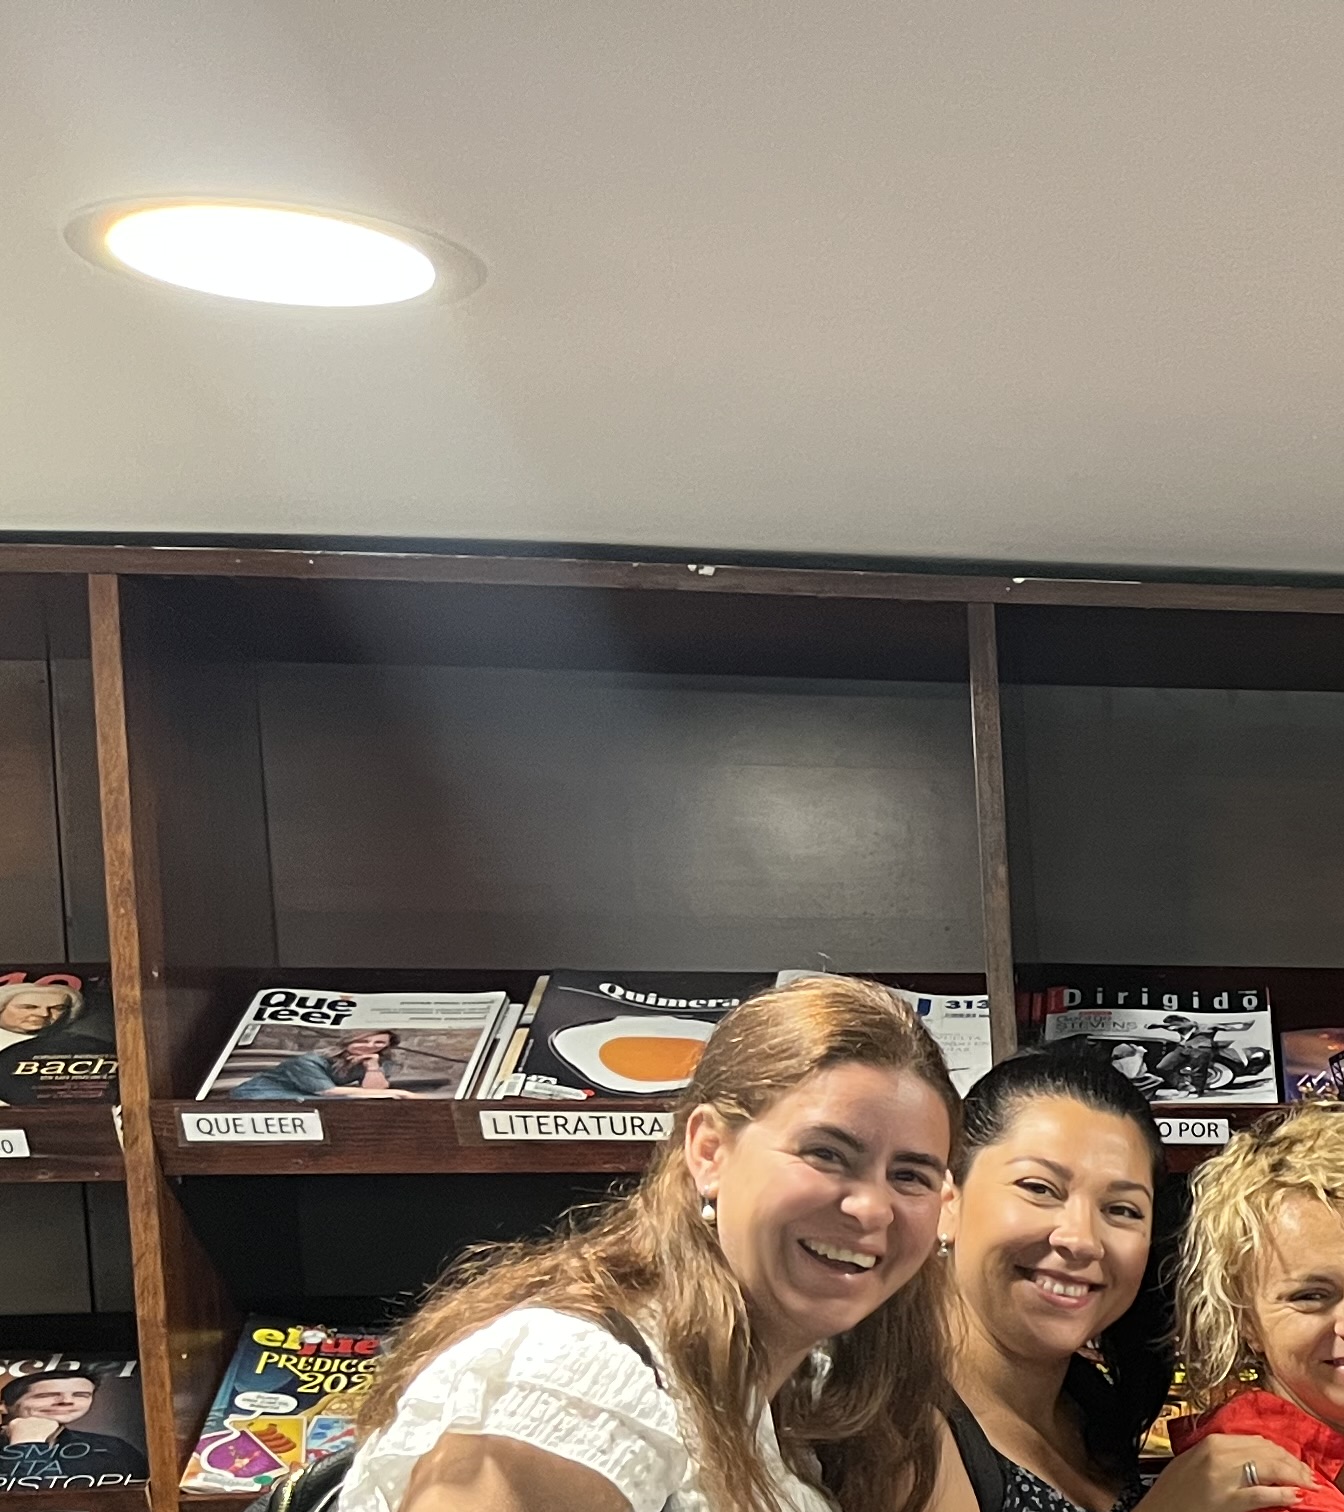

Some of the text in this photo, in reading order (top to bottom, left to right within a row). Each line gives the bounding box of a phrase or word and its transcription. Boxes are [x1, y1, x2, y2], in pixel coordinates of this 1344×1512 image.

[599, 982, 740, 1008] Quimera
[196, 1117, 307, 1136] QUE LEER
[493, 1115, 664, 1136] LITERATURA
[1179, 1121, 1219, 1138] POR
